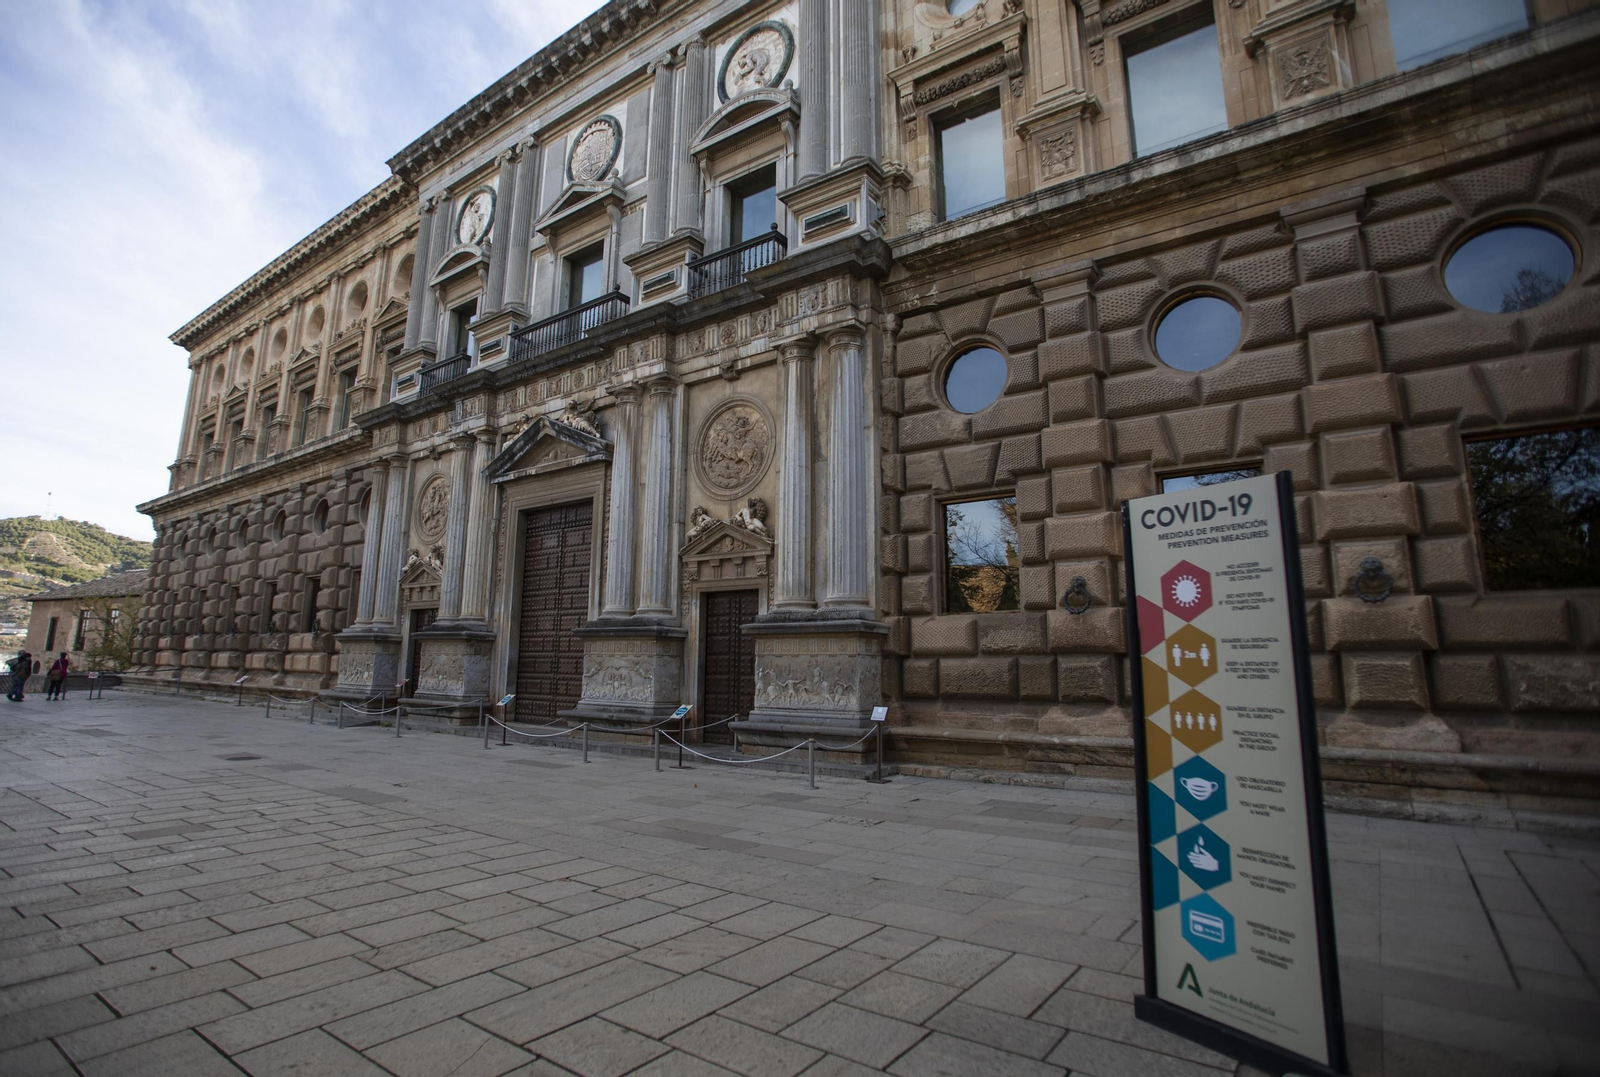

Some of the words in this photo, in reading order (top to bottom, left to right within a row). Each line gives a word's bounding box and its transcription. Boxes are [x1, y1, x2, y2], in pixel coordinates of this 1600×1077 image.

[1141, 493, 1253, 530] COVID-19
[1158, 529, 1195, 541] MEDIDAS
[1196, 527, 1208, 536] DE
[1210, 518, 1268, 533] PREVENCIÓN
[1168, 538, 1220, 549] PREVENTION
[1221, 530, 1269, 543] MEASURES
[1207, 986, 1228, 1000] Junta
[1228, 993, 1238, 1003] de
[1239, 997, 1276, 1018] Andalucía
